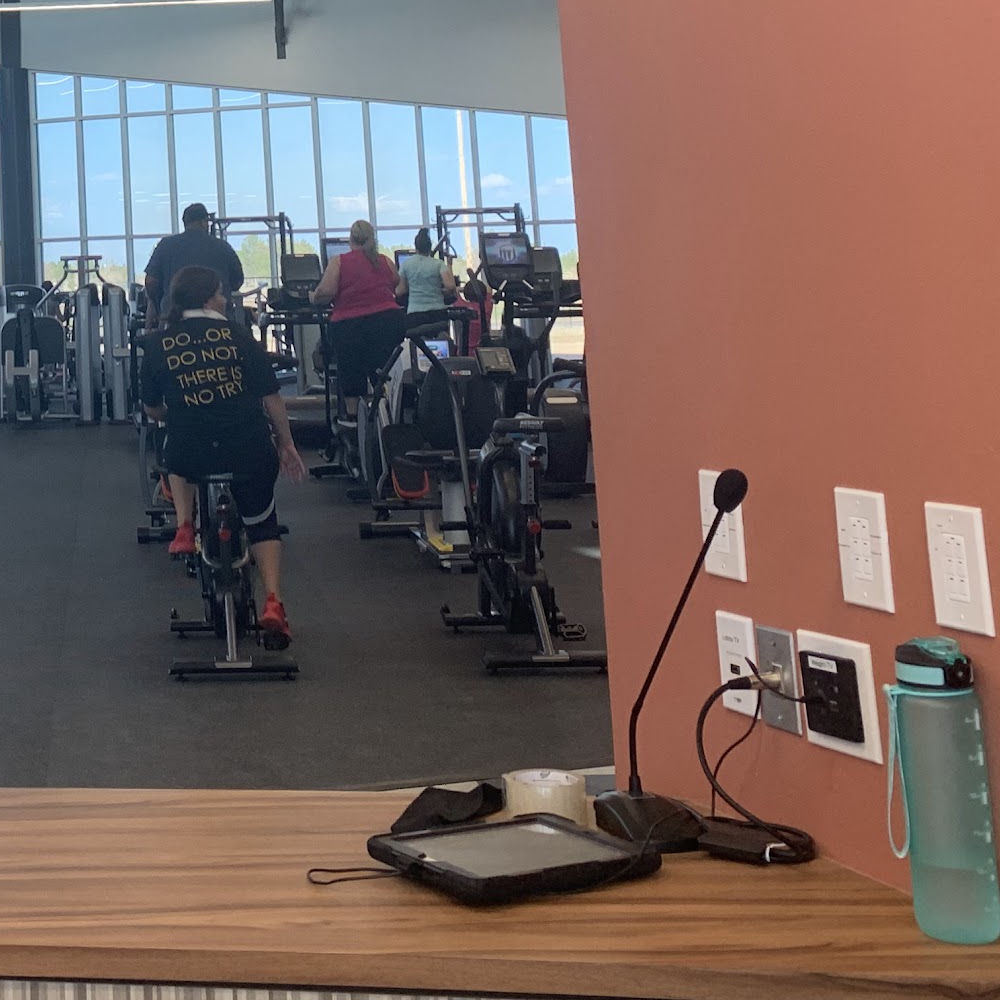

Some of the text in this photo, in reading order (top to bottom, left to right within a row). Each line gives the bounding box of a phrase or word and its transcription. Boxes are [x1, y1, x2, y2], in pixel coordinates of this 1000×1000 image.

[166, 346, 244, 371] DO NOT.
[176, 366, 243, 389] THERE IS
[183, 389, 214, 407] NO
